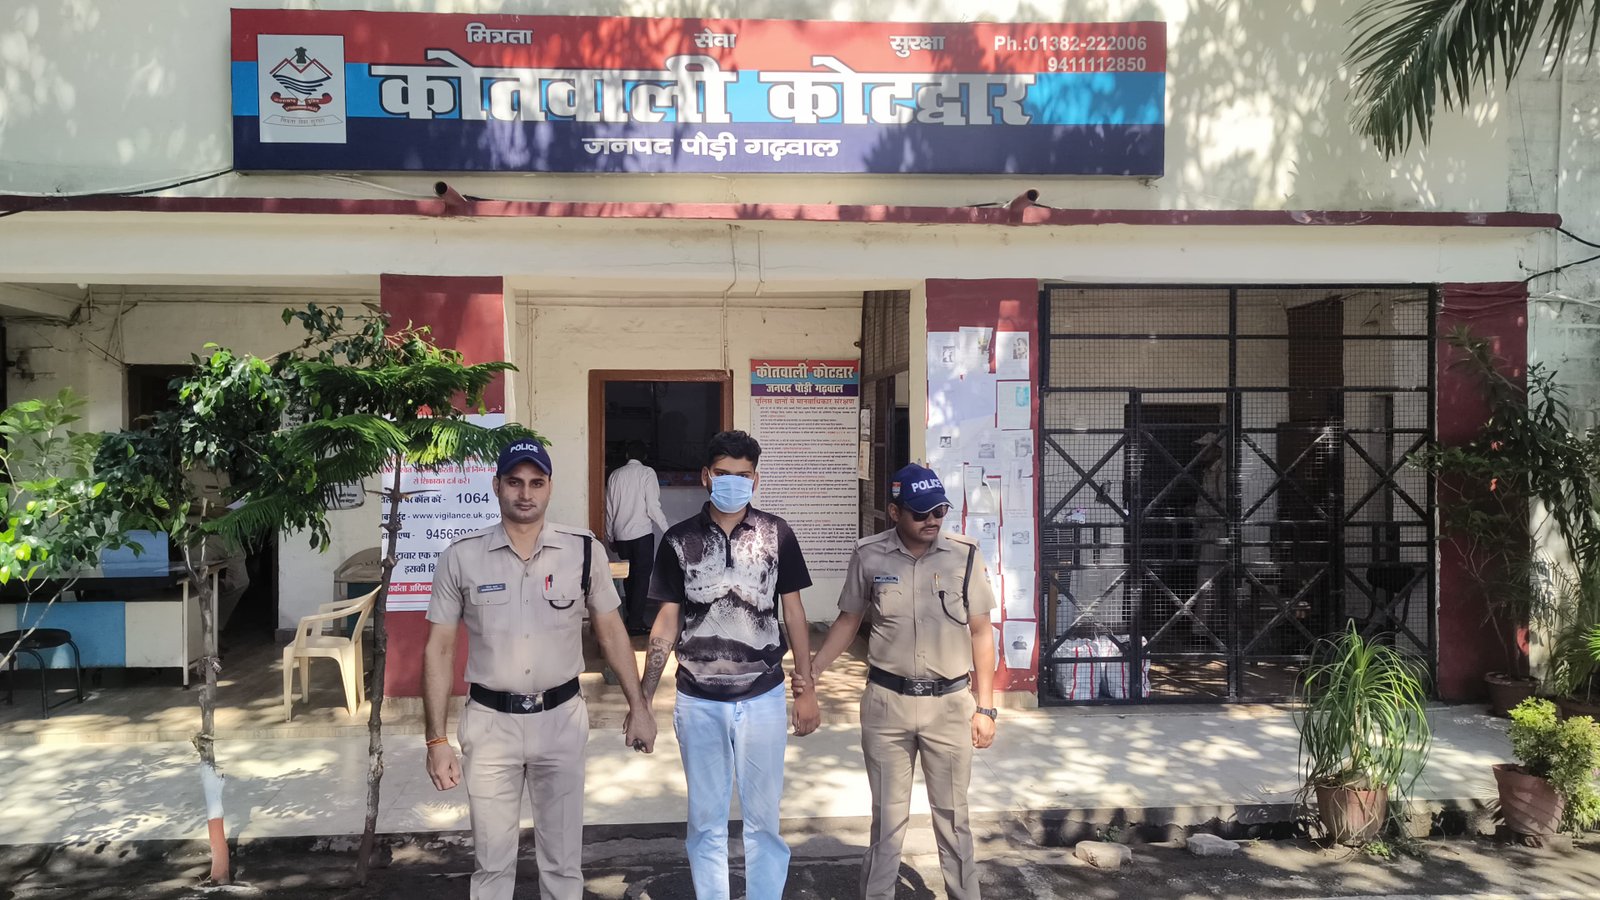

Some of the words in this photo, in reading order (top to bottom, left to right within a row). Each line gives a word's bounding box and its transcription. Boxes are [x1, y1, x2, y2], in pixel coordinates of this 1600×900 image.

[465, 22, 533, 44] मित्रता
[694, 27, 736, 48] सेवा
[889, 35, 946, 58] सुरक्षा
[994, 36, 1147, 51] Ph.:01382-222006
[1048, 57, 1147, 72] 9411112850
[370, 49, 738, 125] कोतवाली
[759, 56, 1036, 126] कोटद्वार
[581, 138, 674, 155] जनपद
[744, 138, 842, 162] गढ़वाल
[755, 363, 808, 379] कोतवाली
[812, 363, 854, 379] कोटद्वार
[765, 384, 792, 393] जनपद
[510, 443, 539, 454] POLICE
[421, 477, 446, 485] शिकायत
[911, 478, 943, 493] POLICE
[415, 495, 430, 504] कॉल
[432, 494, 442, 504] करें
[456, 492, 490, 504] 1064
[412, 511, 501, 521] www.vigilance.uk.gov.
[418, 551, 431, 559] एक
[404, 562, 426, 575] इसकी
